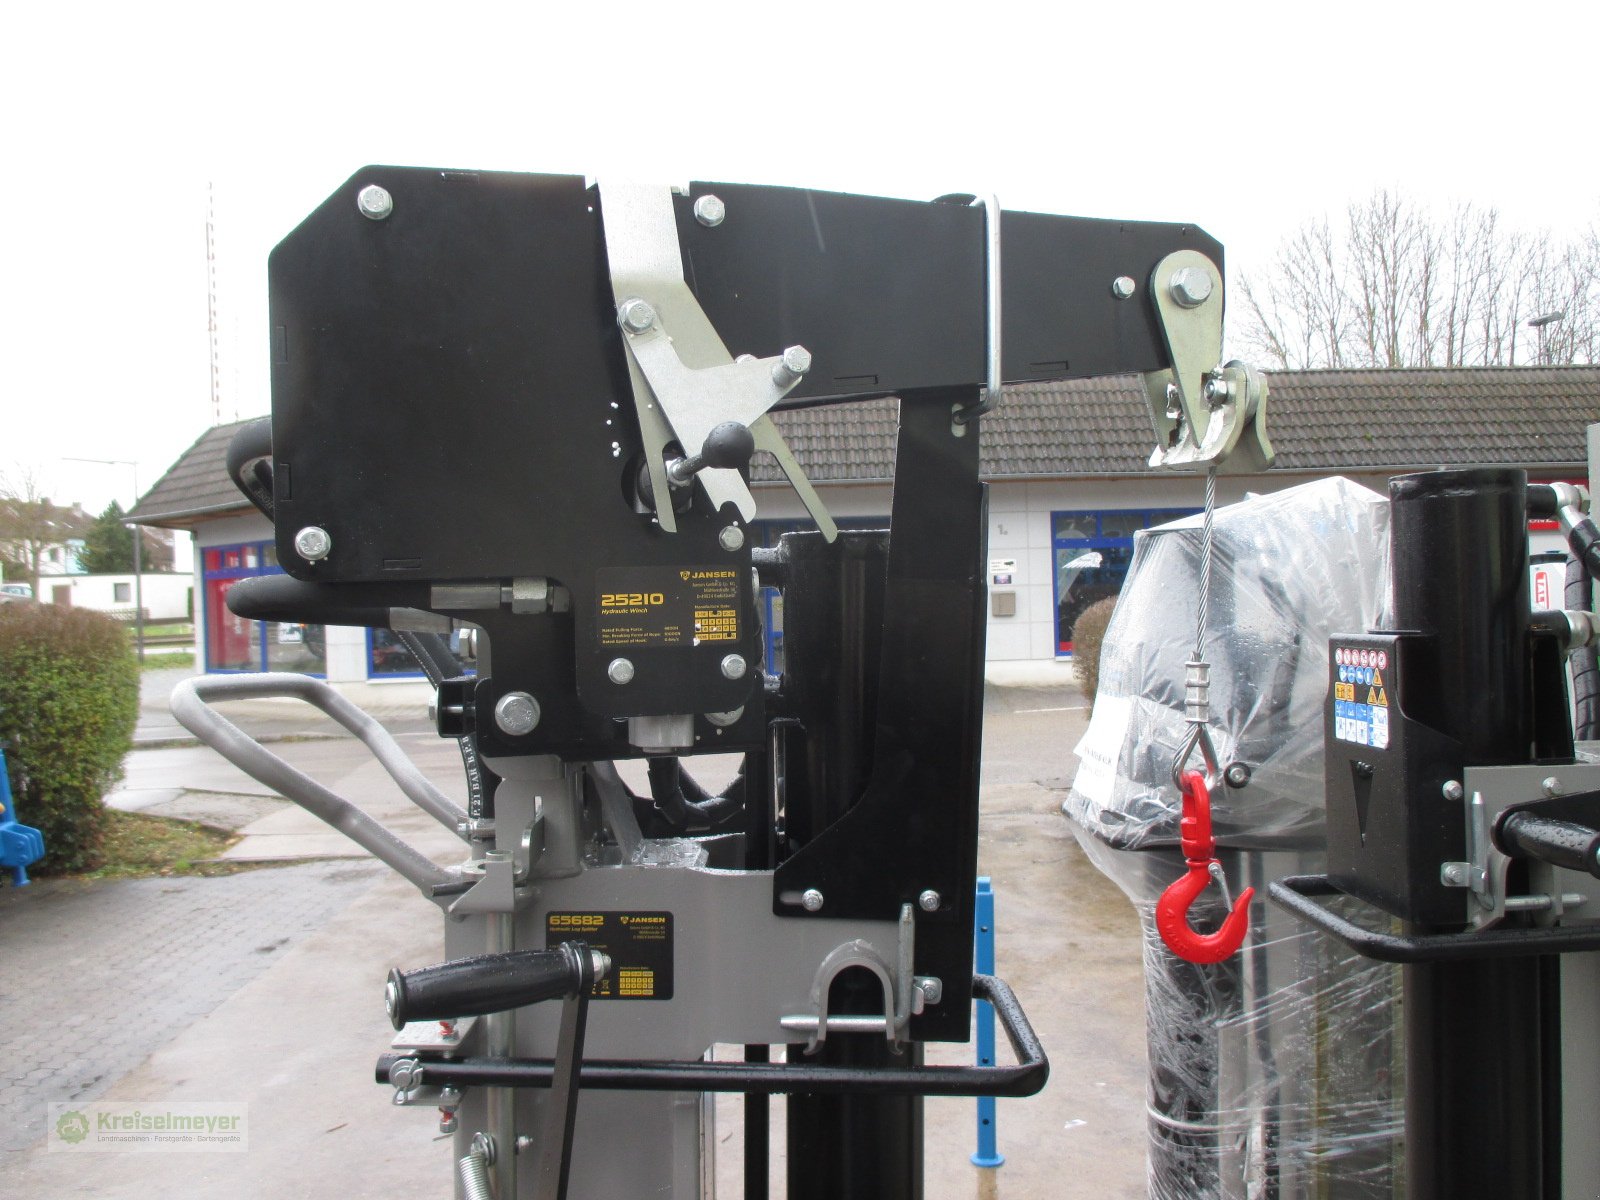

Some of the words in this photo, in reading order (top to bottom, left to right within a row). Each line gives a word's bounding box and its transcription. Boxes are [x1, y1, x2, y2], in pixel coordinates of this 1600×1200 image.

[692, 571, 736, 579] JANSEN
[601, 592, 664, 607] 25210
[549, 915, 604, 926] 65682
